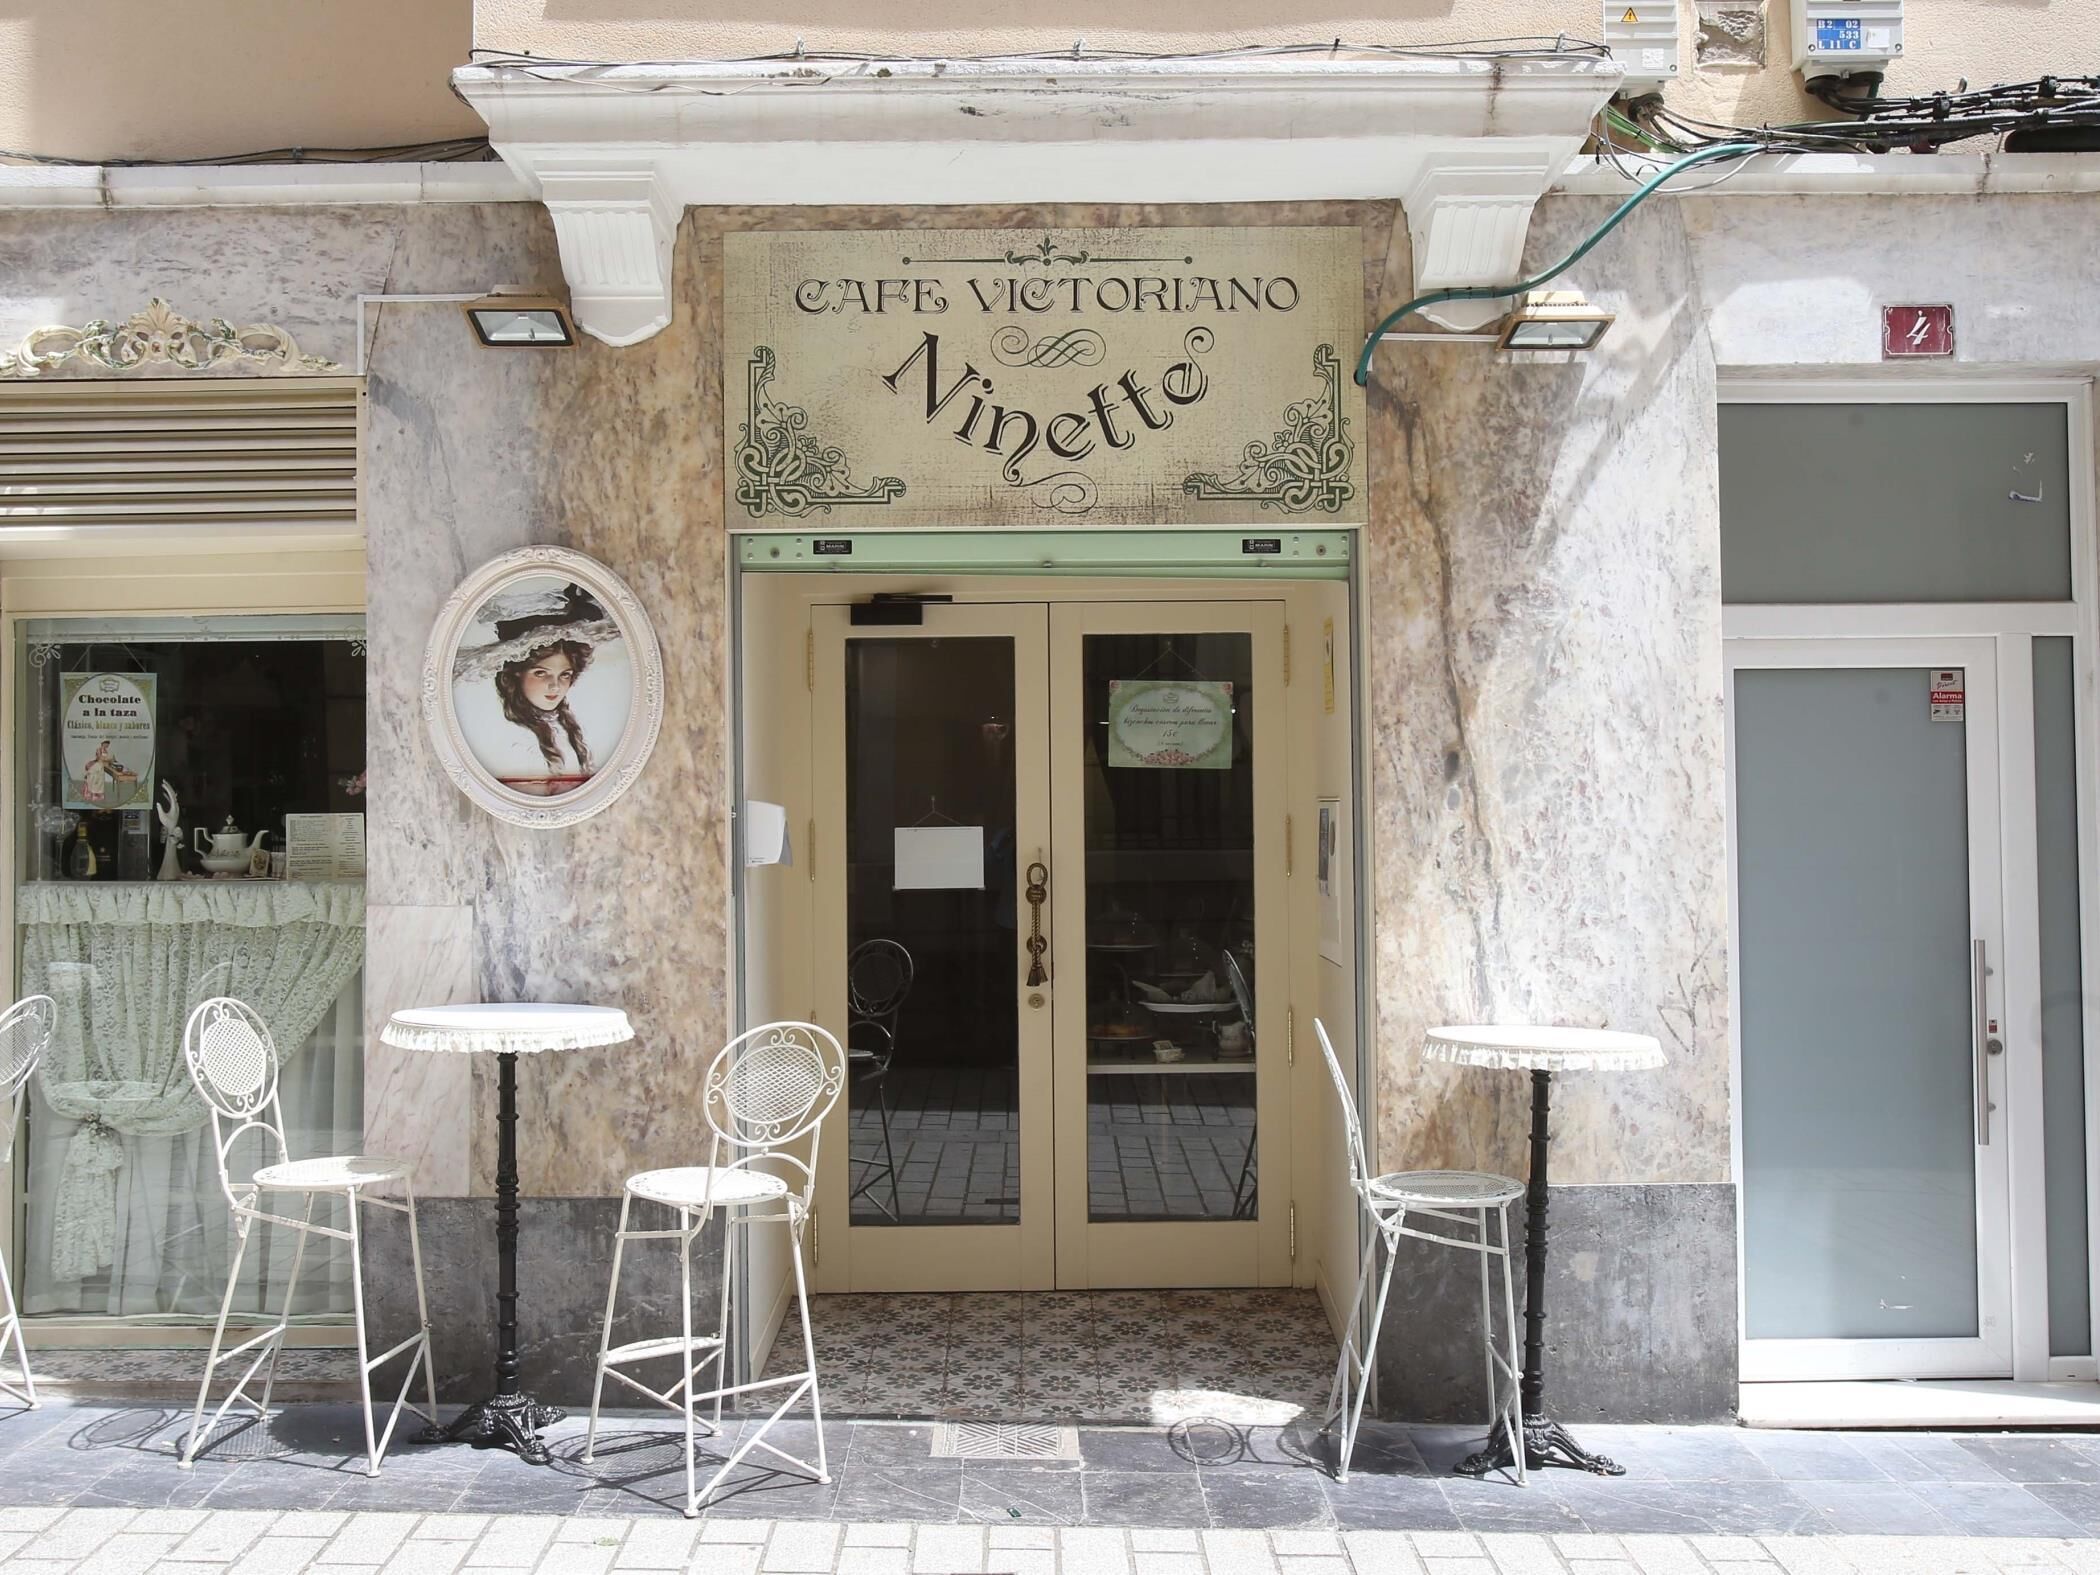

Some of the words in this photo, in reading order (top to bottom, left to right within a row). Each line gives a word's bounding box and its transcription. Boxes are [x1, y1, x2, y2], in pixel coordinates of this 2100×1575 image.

[1818, 20, 1833, 29] B2
[1845, 20, 1859, 29] 02
[1839, 30, 1860, 39] 533
[1849, 40, 1857, 49] C
[794, 277, 949, 315] CAFE
[967, 276, 1301, 314] VICTORIANO
[1905, 310, 1931, 345] 4
[881, 325, 1216, 487] Ninette
[79, 695, 141, 704] Chocolate
[95, 708, 106, 717] la
[110, 708, 137, 717] taza
